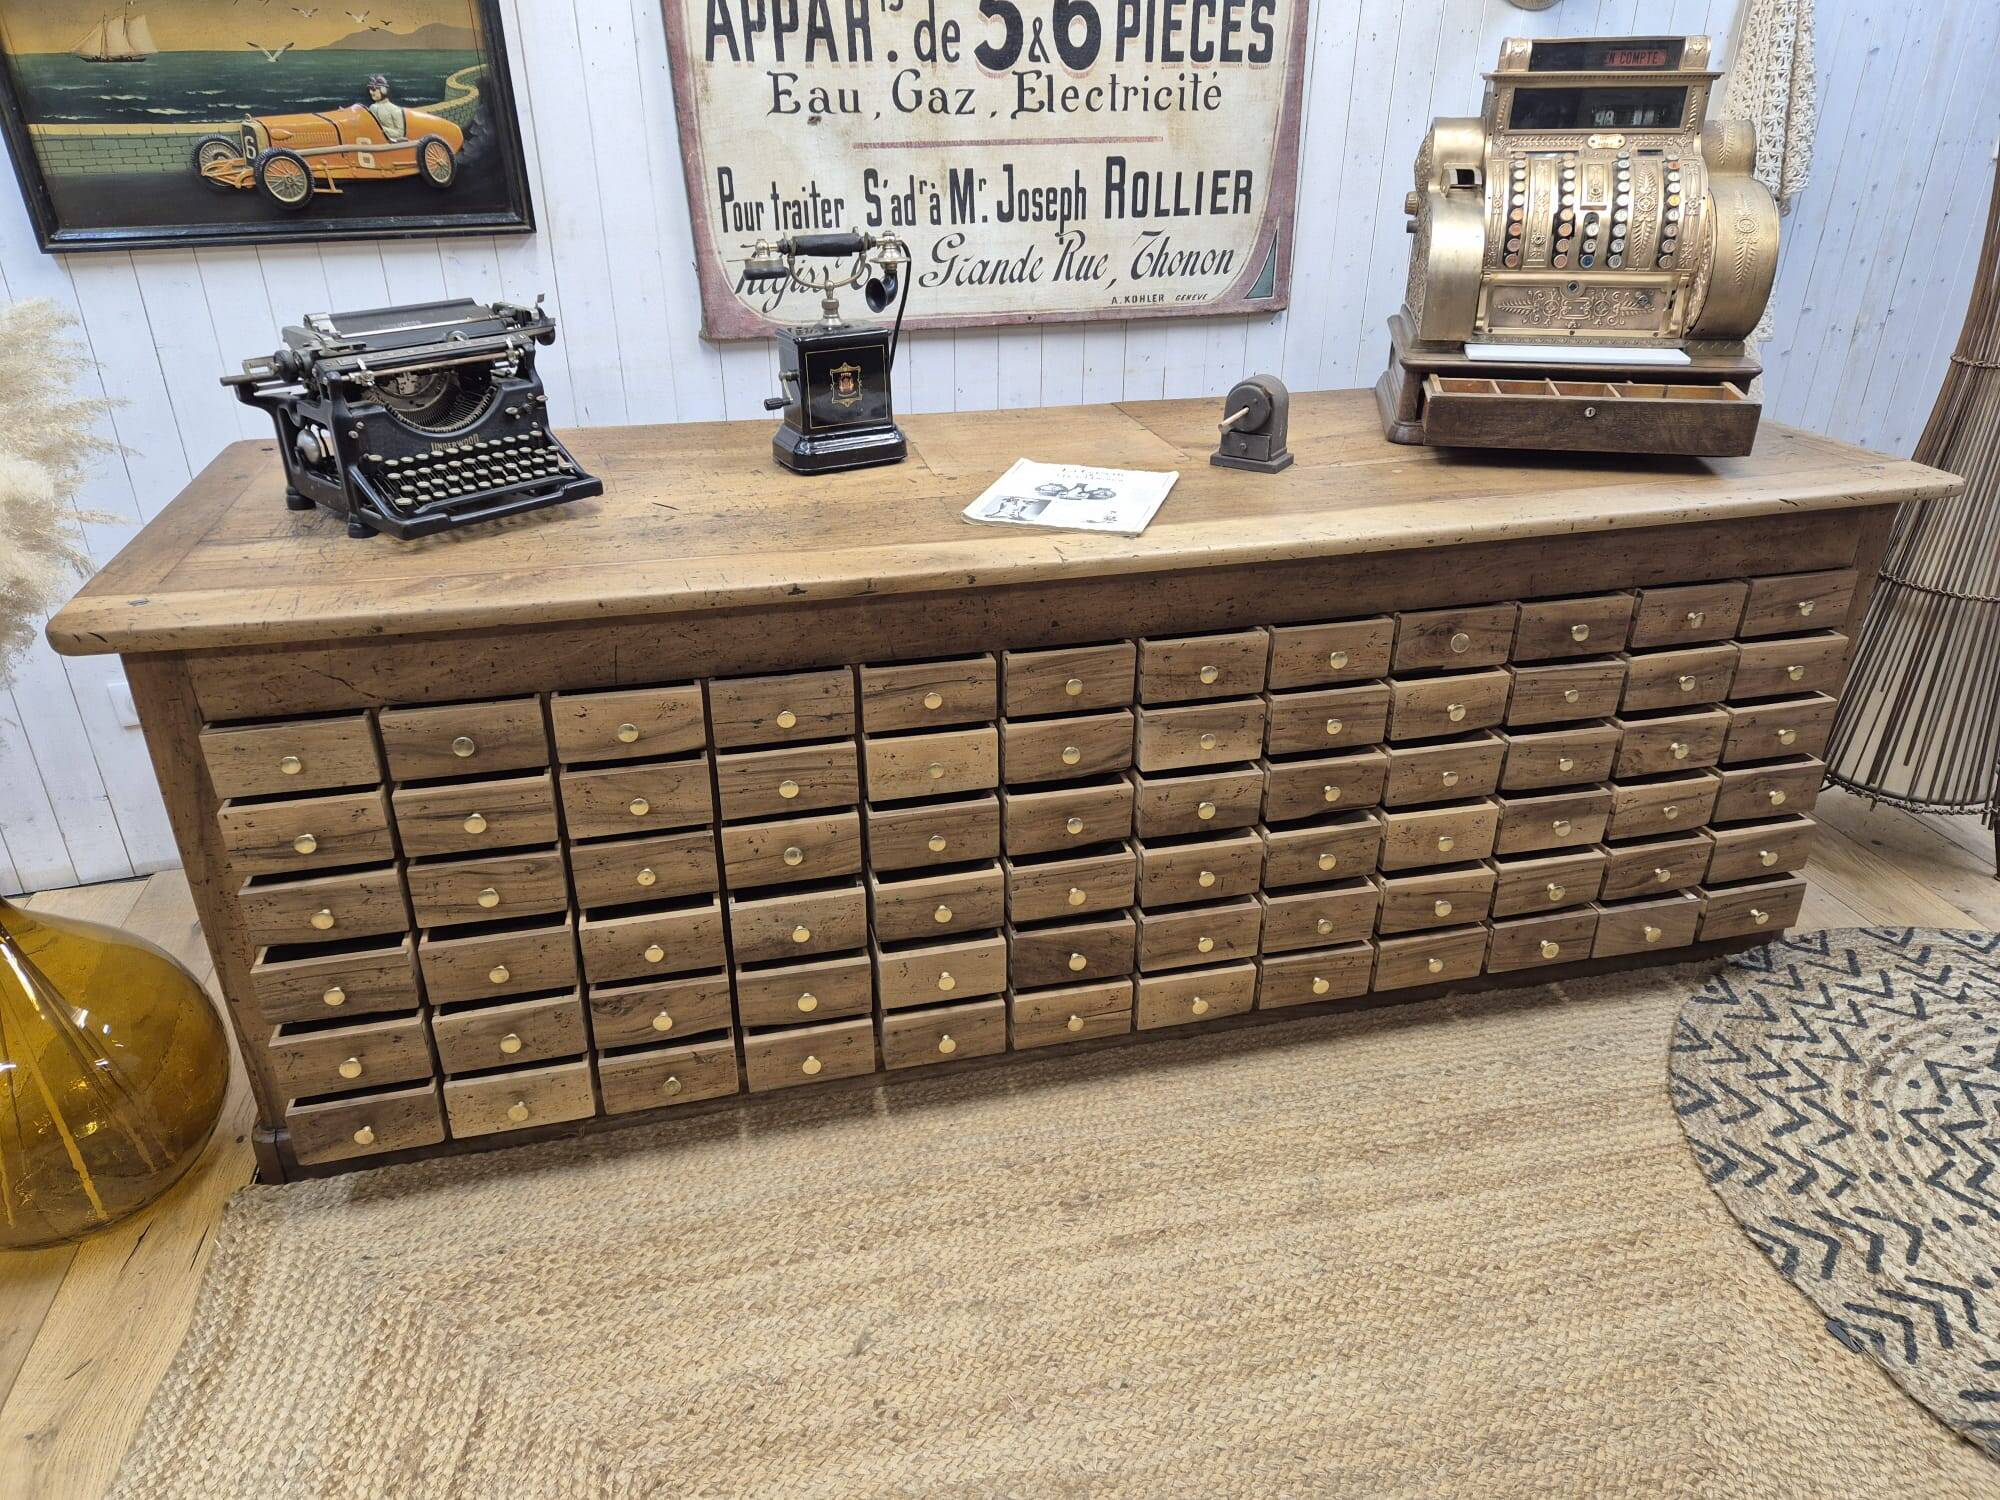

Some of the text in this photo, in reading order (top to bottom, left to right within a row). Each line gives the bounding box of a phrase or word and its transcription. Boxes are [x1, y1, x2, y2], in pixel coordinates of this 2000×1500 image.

[912, 0, 961, 63] de
[1620, 50, 1658, 65] COMPTE
[1010, 69, 1223, 119] Electricité
[244, 135, 257, 160] 6
[717, 166, 764, 233] Pour
[770, 180, 845, 231] traiter
[996, 163, 1087, 245] Joseph
[1104, 156, 1253, 219] ROLLIER
[918, 232, 1044, 288] Grande
[1051, 229, 1118, 290] Rue,
[1130, 226, 1235, 281] Thonon
[431, 432, 480, 453] UNDERWOOD
